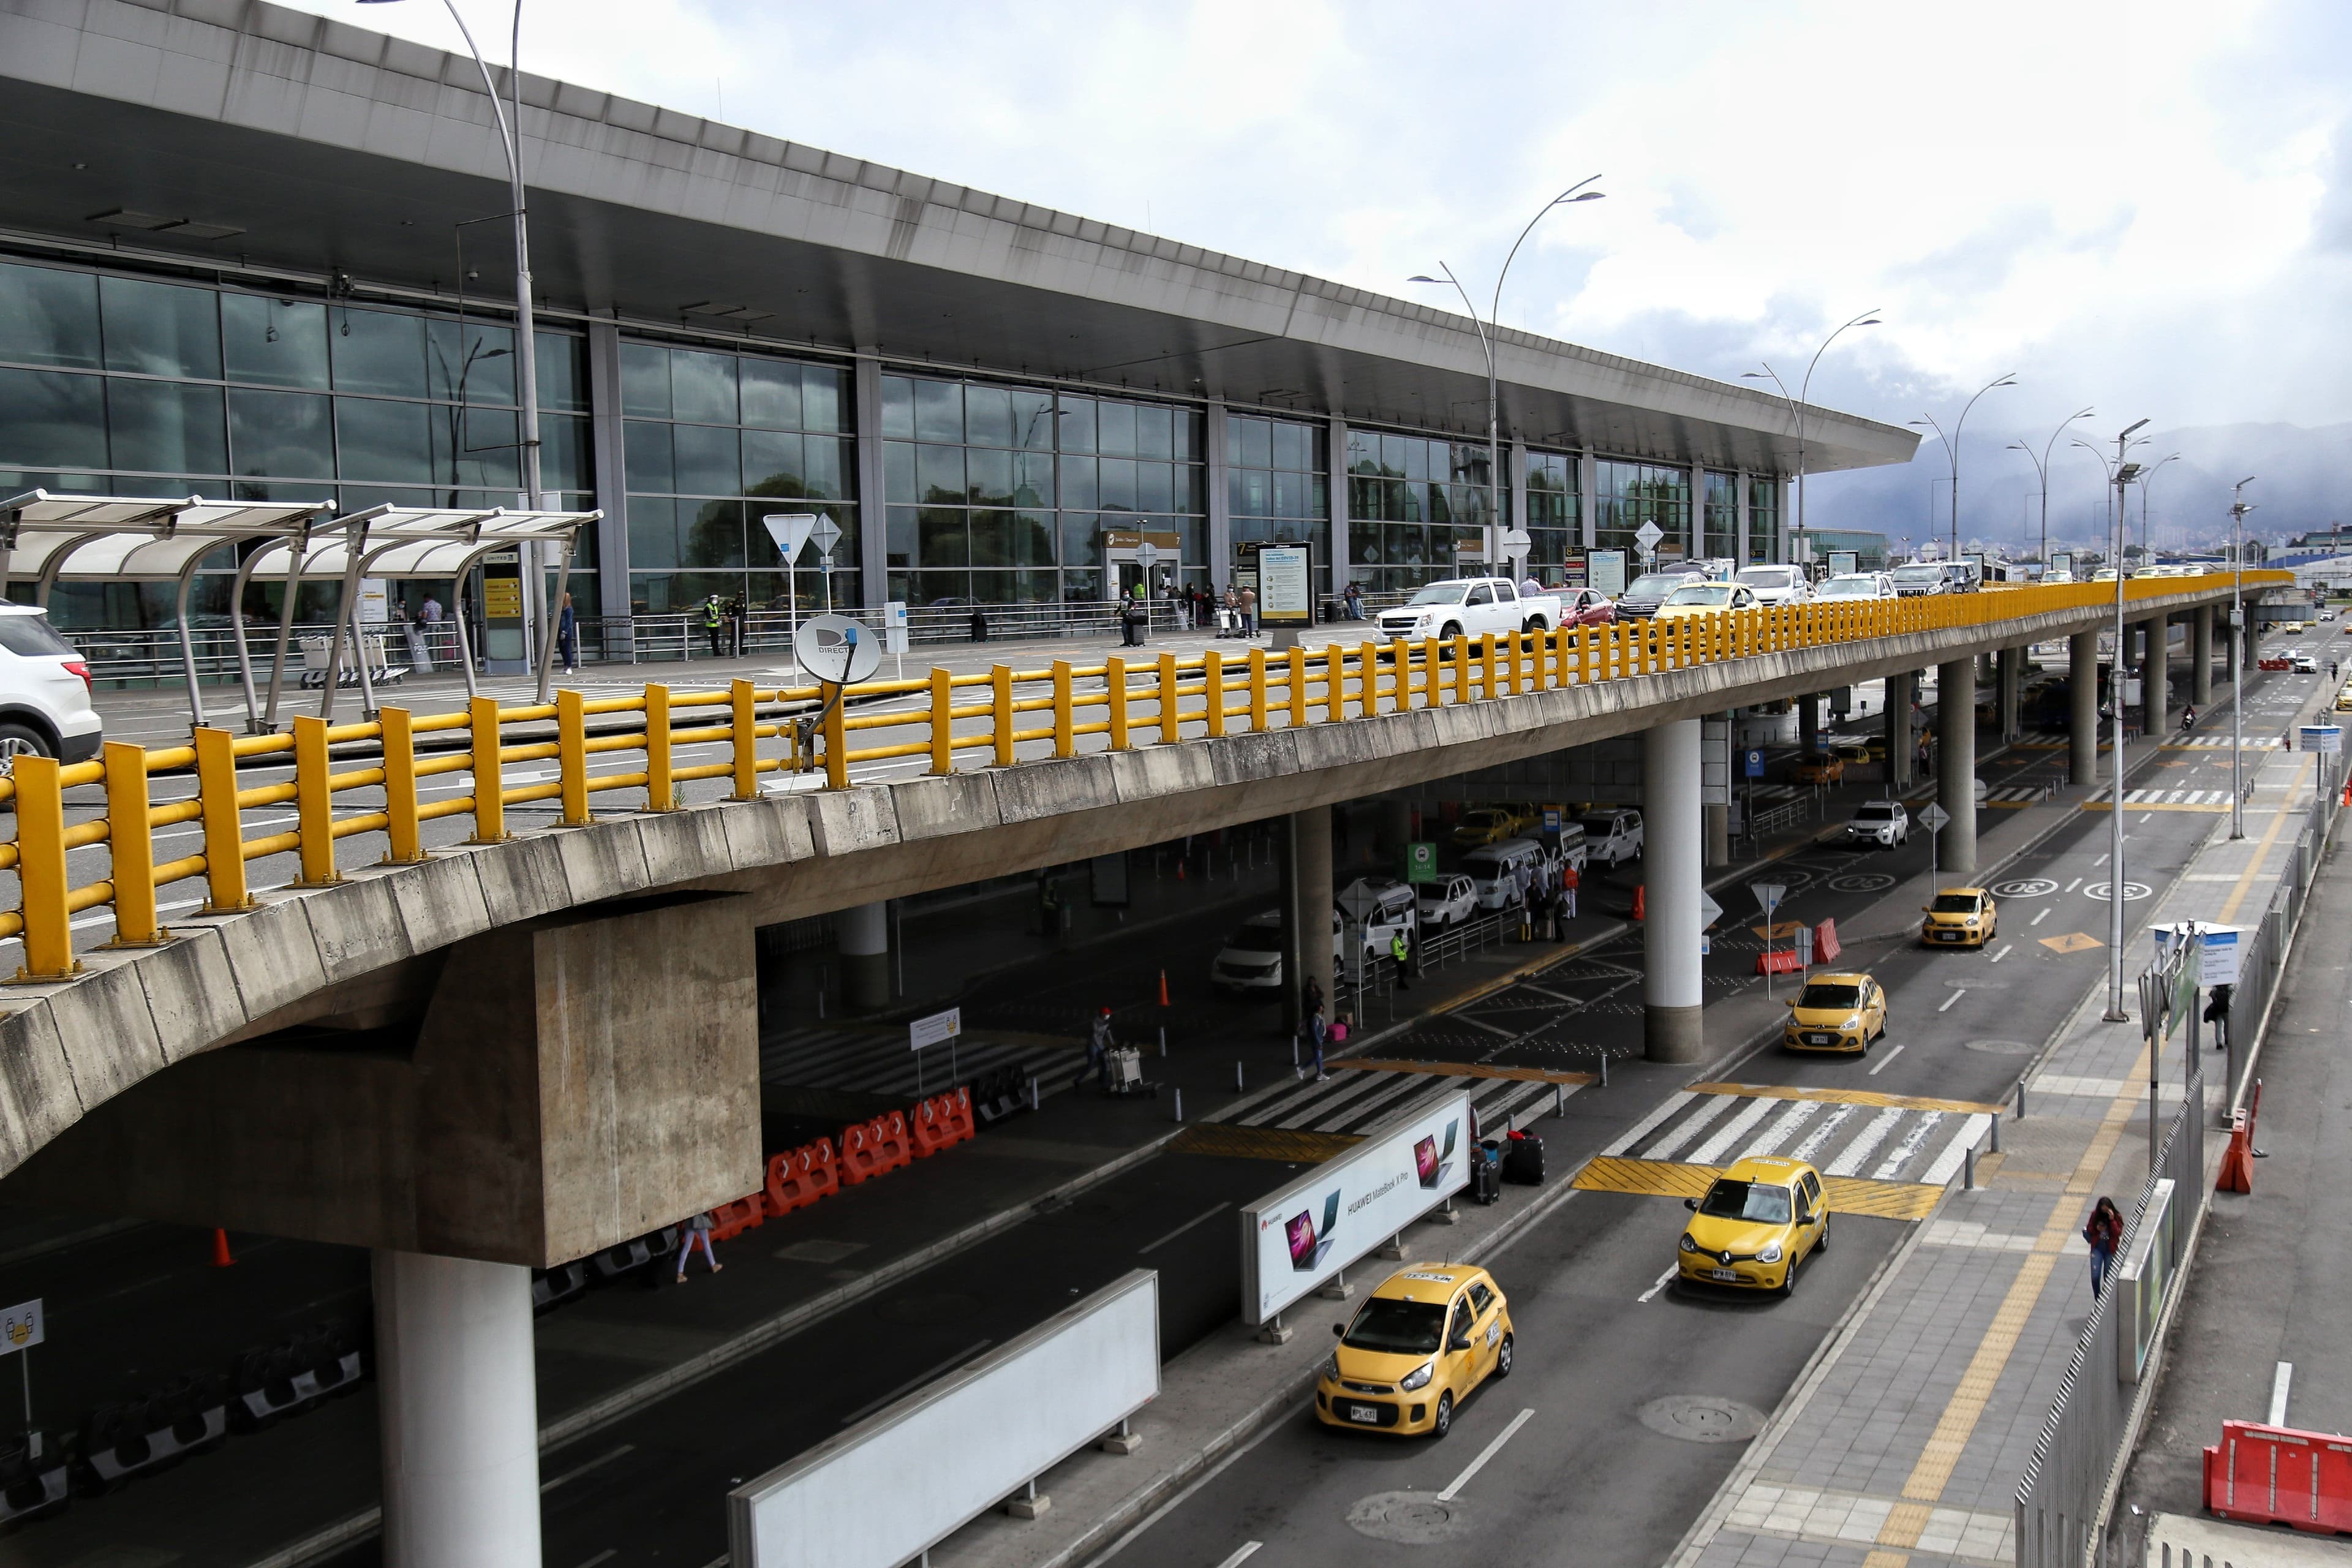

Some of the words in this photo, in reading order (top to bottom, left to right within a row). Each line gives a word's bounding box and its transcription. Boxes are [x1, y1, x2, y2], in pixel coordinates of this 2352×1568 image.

[1238, 543, 1246, 555] 7
[1566, 547, 1573, 556] 8
[1841, 877, 1884, 888] 30
[2003, 882, 2045, 894] 30
[1348, 1193, 1373, 1217] HUAWEI
[1373, 1177, 1395, 1200] MateBook
[1396, 1175, 1401, 1186] X
